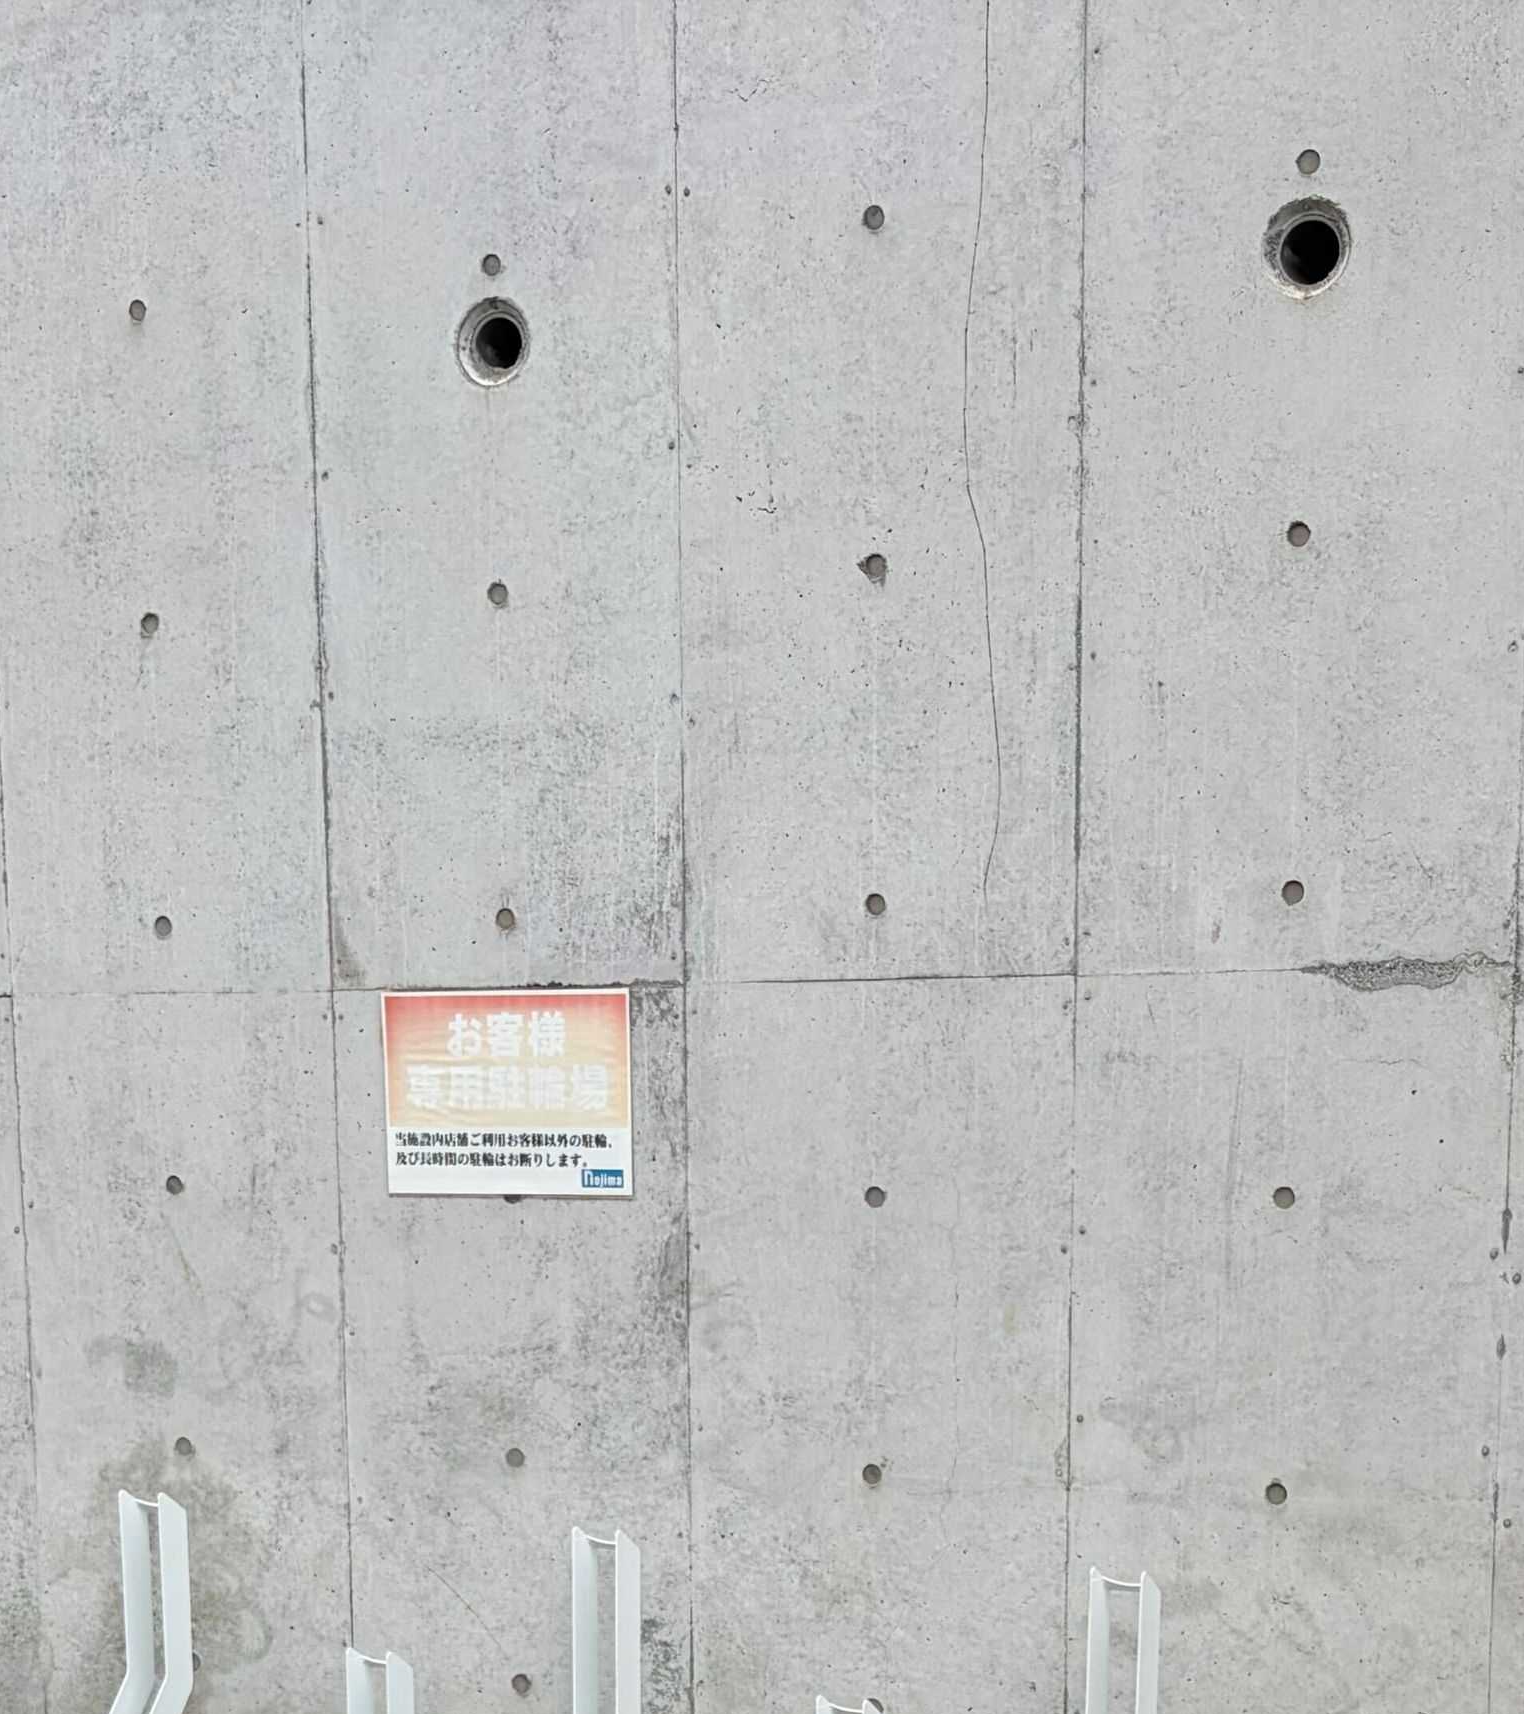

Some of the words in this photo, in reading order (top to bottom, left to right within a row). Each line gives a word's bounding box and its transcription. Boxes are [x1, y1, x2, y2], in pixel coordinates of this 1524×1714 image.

[446, 1010, 566, 1057] お客様
[395, 1151, 588, 1168] 及び長時間の駐輪はお断りします。
